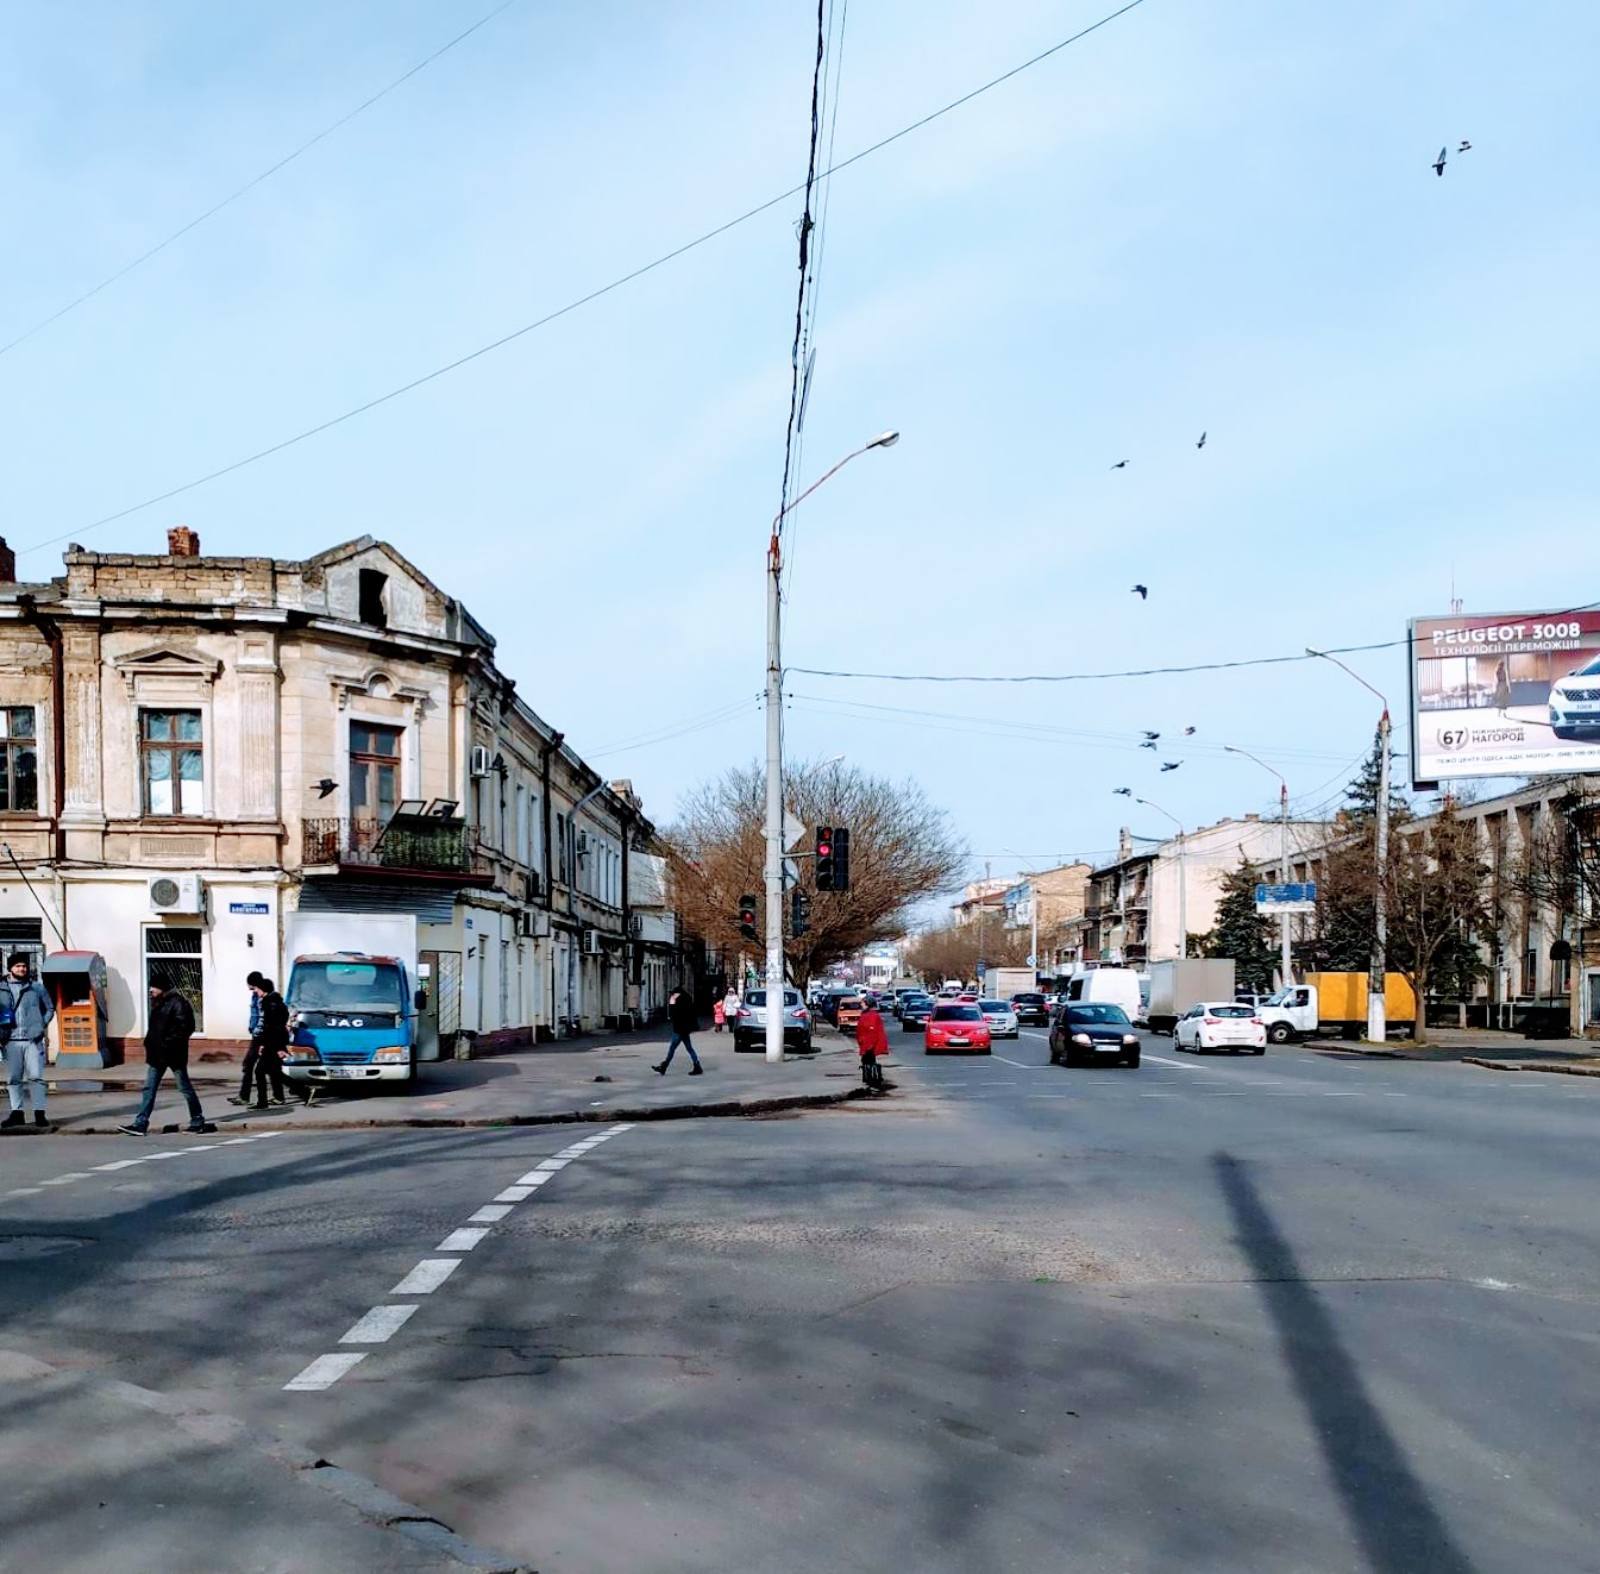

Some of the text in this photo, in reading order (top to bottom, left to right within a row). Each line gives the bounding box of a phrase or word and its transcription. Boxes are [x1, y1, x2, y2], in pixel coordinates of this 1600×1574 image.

[1433, 622, 1580, 645] PEUGEOT 3008
[1434, 639, 1581, 657] ТЕХНОЛОГІЇ ПЕРЕМОЖЦІВ
[1443, 730, 1464, 745] 67
[1472, 732, 1525, 743] НАГОРОД
[326, 1017, 364, 1027] JAC
